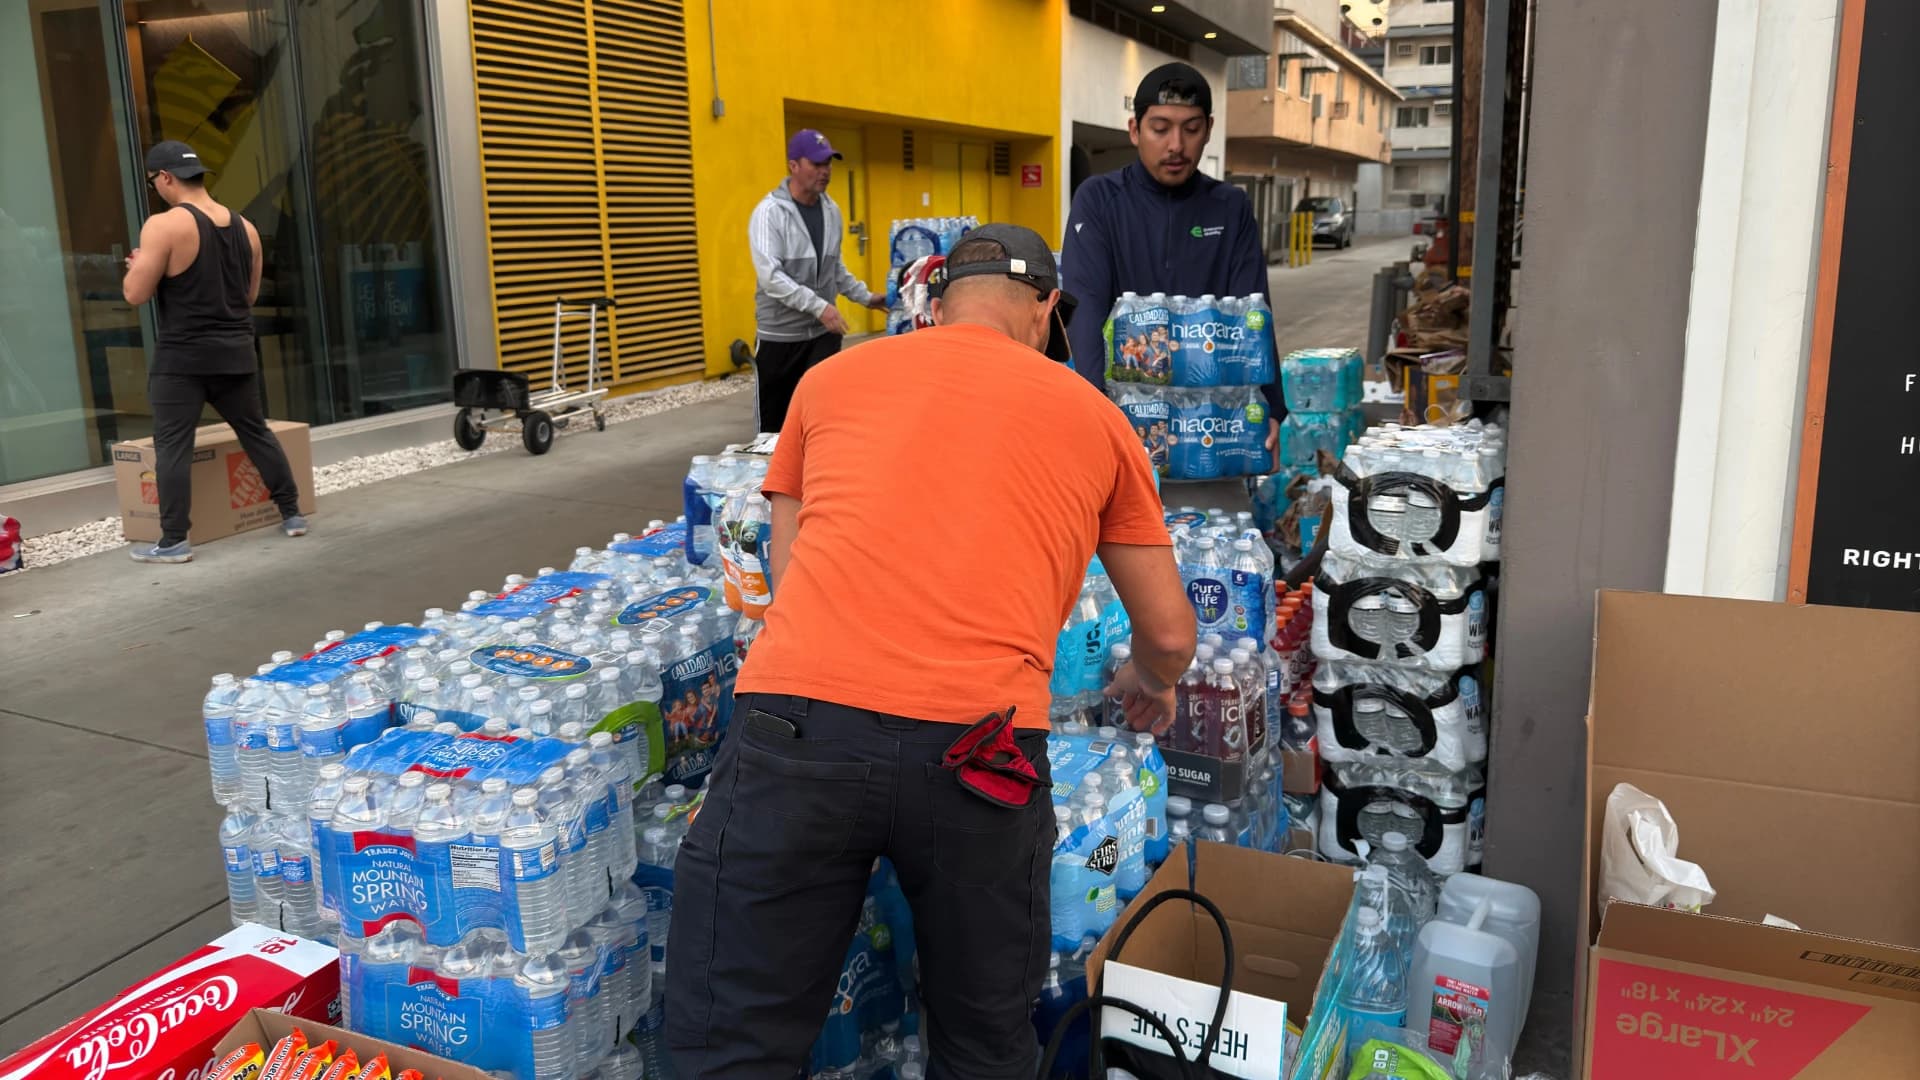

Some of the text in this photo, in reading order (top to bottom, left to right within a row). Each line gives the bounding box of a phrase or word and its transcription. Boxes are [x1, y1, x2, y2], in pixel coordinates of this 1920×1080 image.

[1172, 322, 1245, 341] niagara
[1171, 417, 1245, 435] niagara
[1901, 437, 1920, 454] H
[117, 451, 139, 461] LARGE
[1192, 582, 1221, 595] Pure
[1195, 594, 1218, 606] Life
[671, 655, 706, 680] CALIDAD
[714, 652, 737, 678] nia
[1189, 701, 1204, 717] IC
[1141, 775, 1154, 791] 24
[1178, 768, 1211, 783] SUGAR
[364, 847, 398, 857] TRADER
[451, 845, 484, 853] Nutrition
[1094, 842, 1116, 860] FIRS
[373, 860, 412, 872] NATURAL
[1090, 853, 1117, 870] STRE
[352, 869, 424, 890] MOUNTAIN
[352, 882, 428, 910] SPRING
[370, 899, 421, 915] WATER
[260, 940, 298, 954] 18
[420, 994, 446, 1009] NATURAL
[1437, 995, 1482, 1016] ARROWHEAD
[1621, 981, 1795, 1028] 24" x 24" x 18"
[79, 986, 185, 1041] ORIGINAL TASTE
[401, 1001, 466, 1025] MOUNTAIN
[66, 975, 238, 1080] Coca-Cola
[400, 1013, 468, 1045] SPRING
[416, 1032, 452, 1057] WATER
[1616, 1011, 1759, 1066] XLarge
[218, 1047, 247, 1072] Ramen
